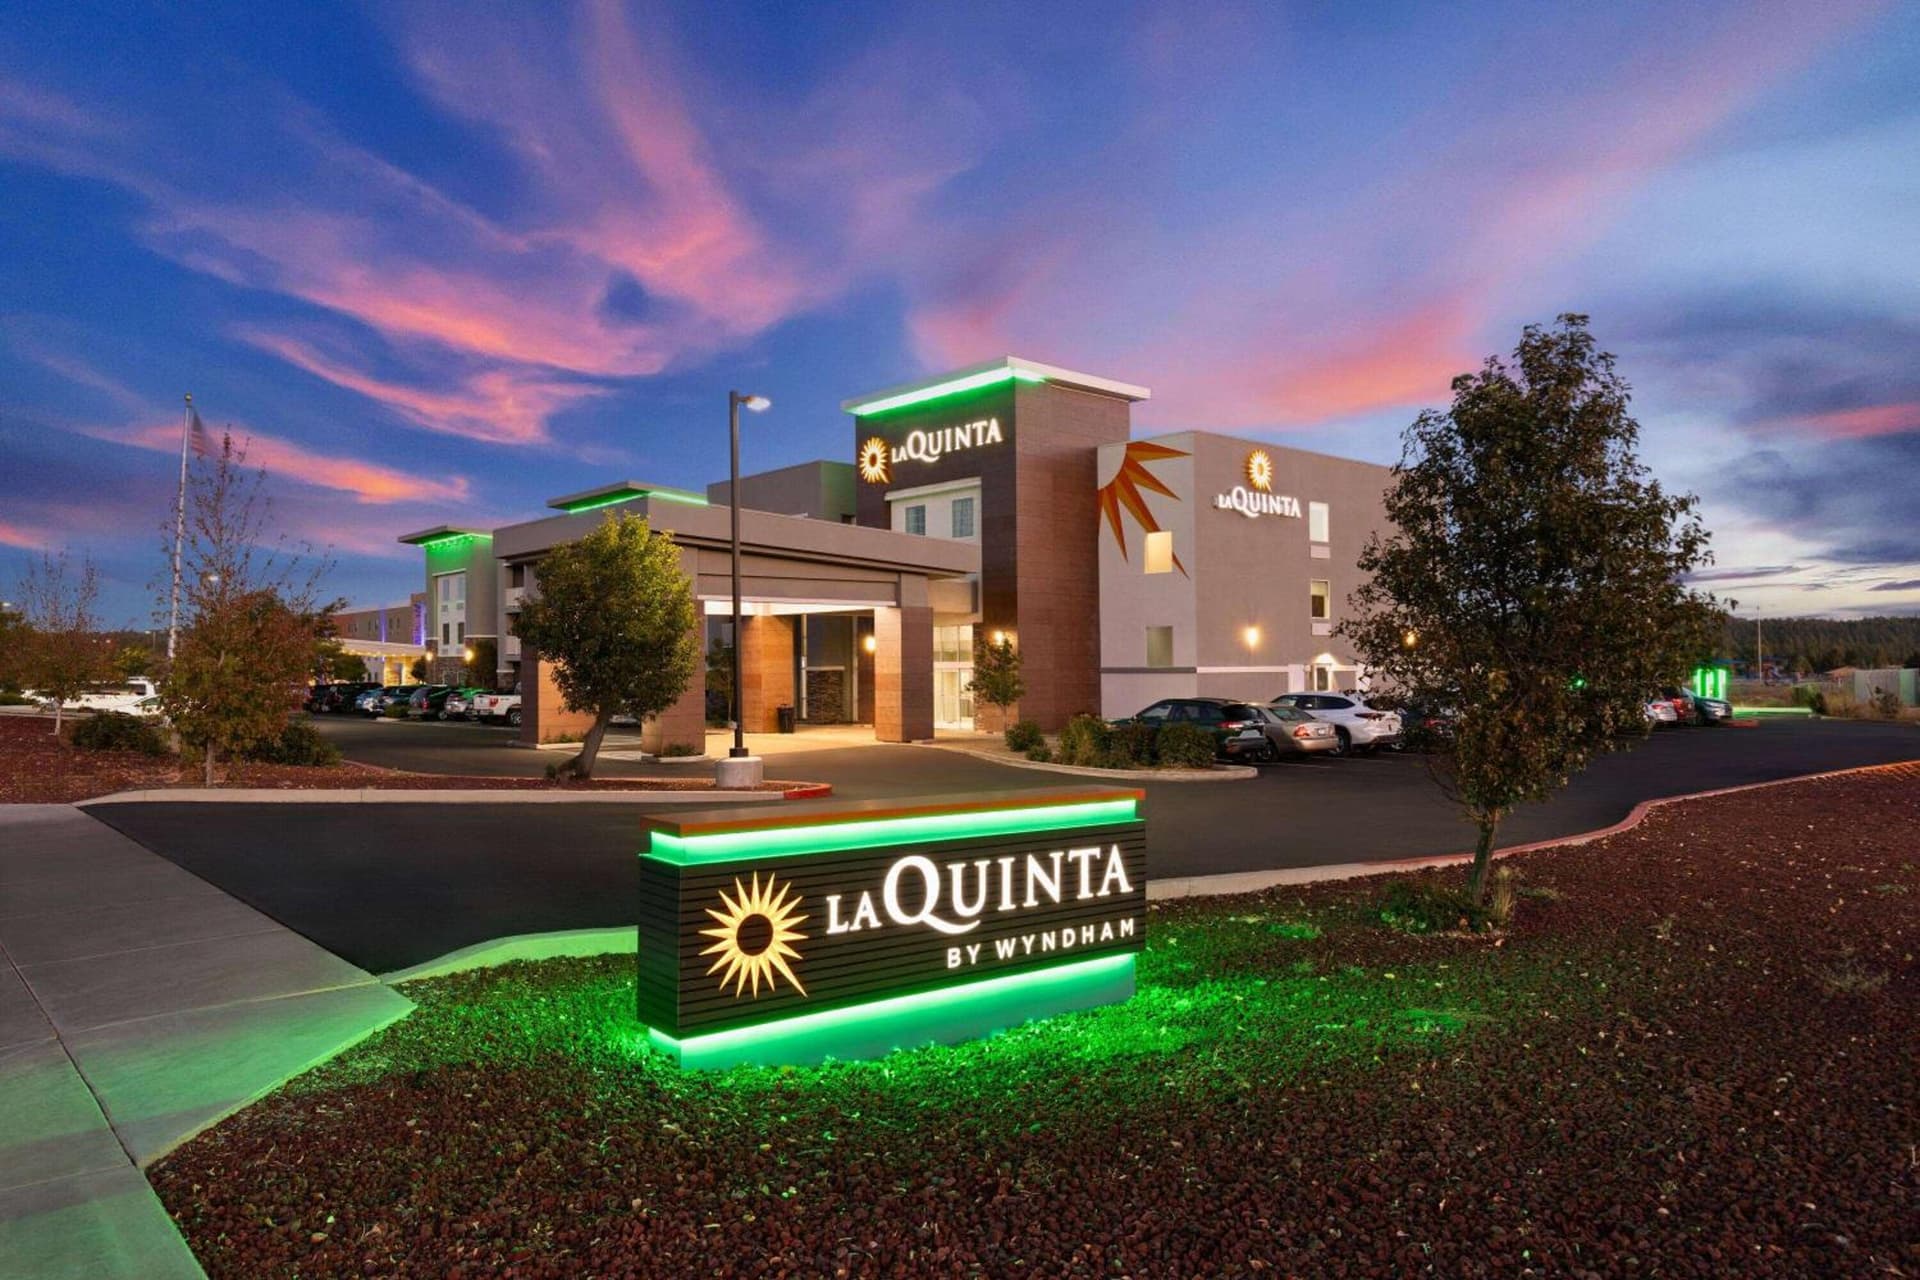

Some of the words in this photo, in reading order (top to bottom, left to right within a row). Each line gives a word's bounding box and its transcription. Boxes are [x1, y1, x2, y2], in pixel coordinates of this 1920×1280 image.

[891, 447, 907, 463] LA
[906, 417, 1003, 463] QUINTA
[1218, 494, 1233, 508] LA
[1231, 486, 1302, 518] QUINTA
[825, 891, 882, 936] LA
[883, 843, 1134, 935] QUINTA
[946, 943, 981, 969] BY
[995, 918, 1135, 960] WYNDHAM
